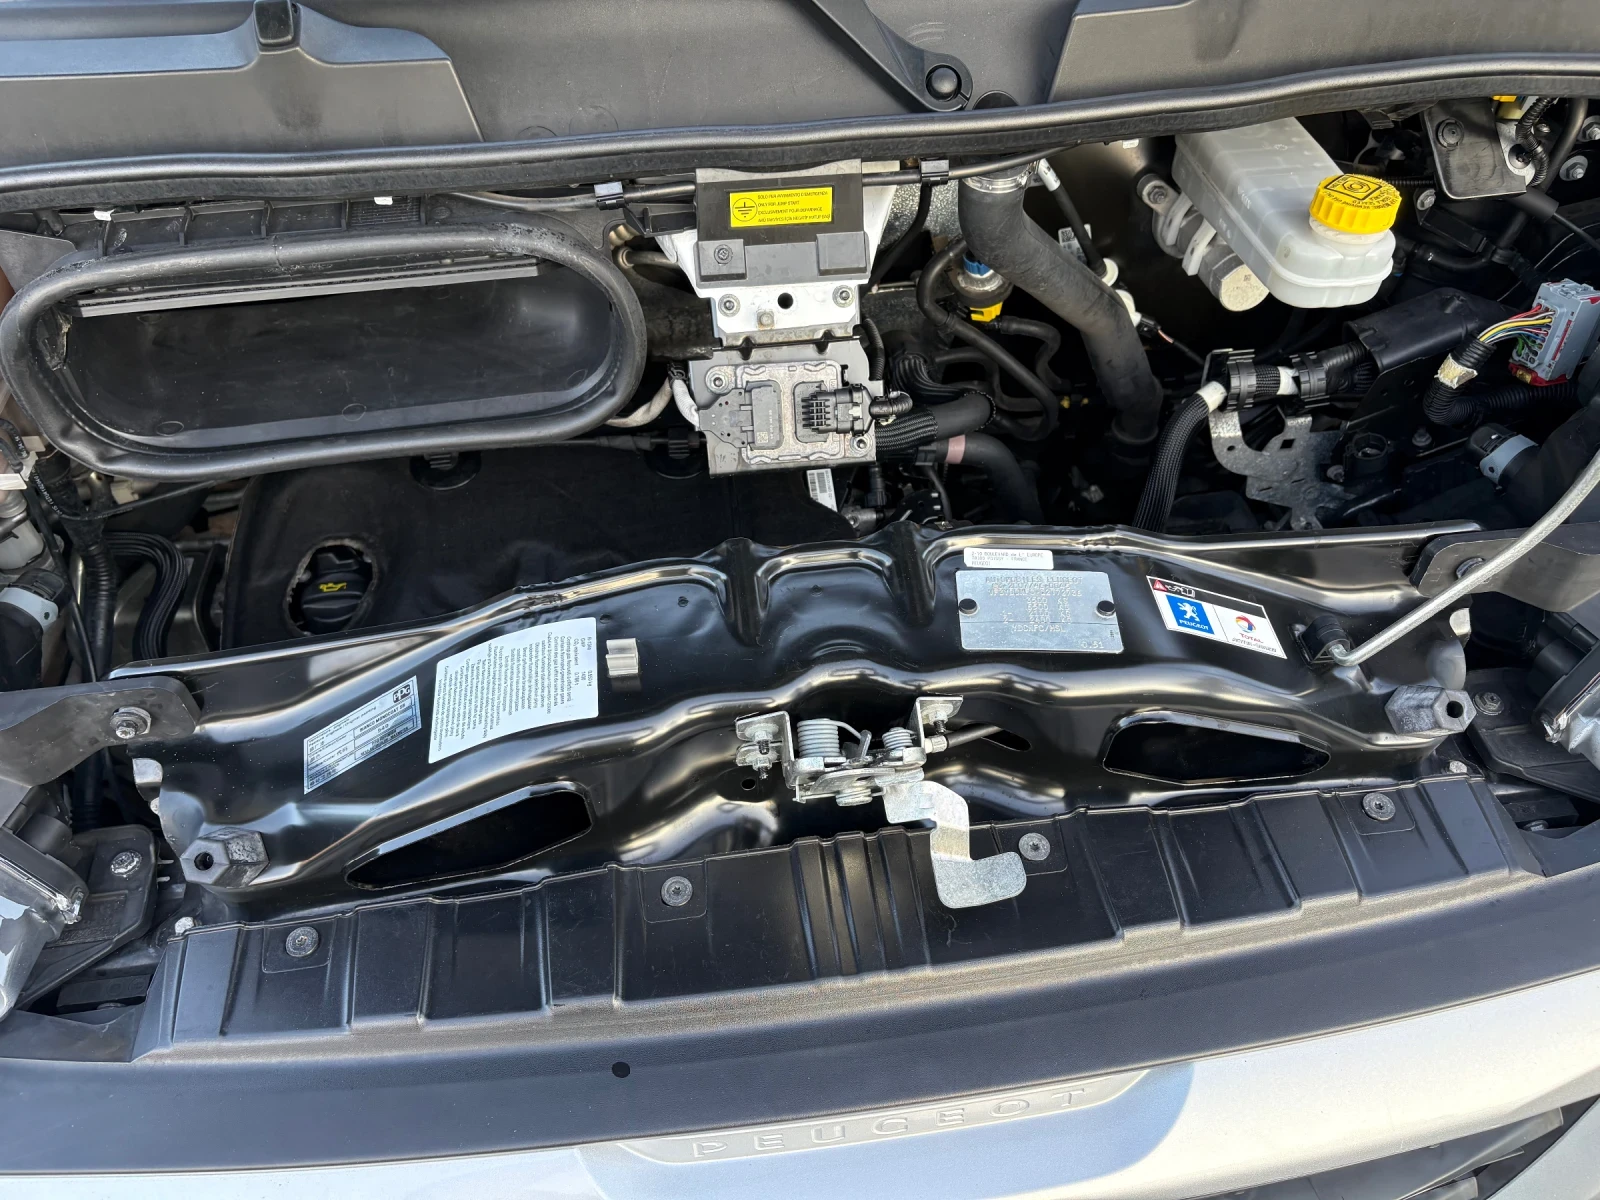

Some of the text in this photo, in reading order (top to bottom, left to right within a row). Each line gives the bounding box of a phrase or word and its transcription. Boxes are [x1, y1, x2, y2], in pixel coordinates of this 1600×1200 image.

[1179, 619, 1209, 630] PEUGEOT
[1239, 632, 1264, 643] TOTAL
[393, 684, 411, 703] PPG
[691, 1087, 1091, 1158] PEUGEOT
